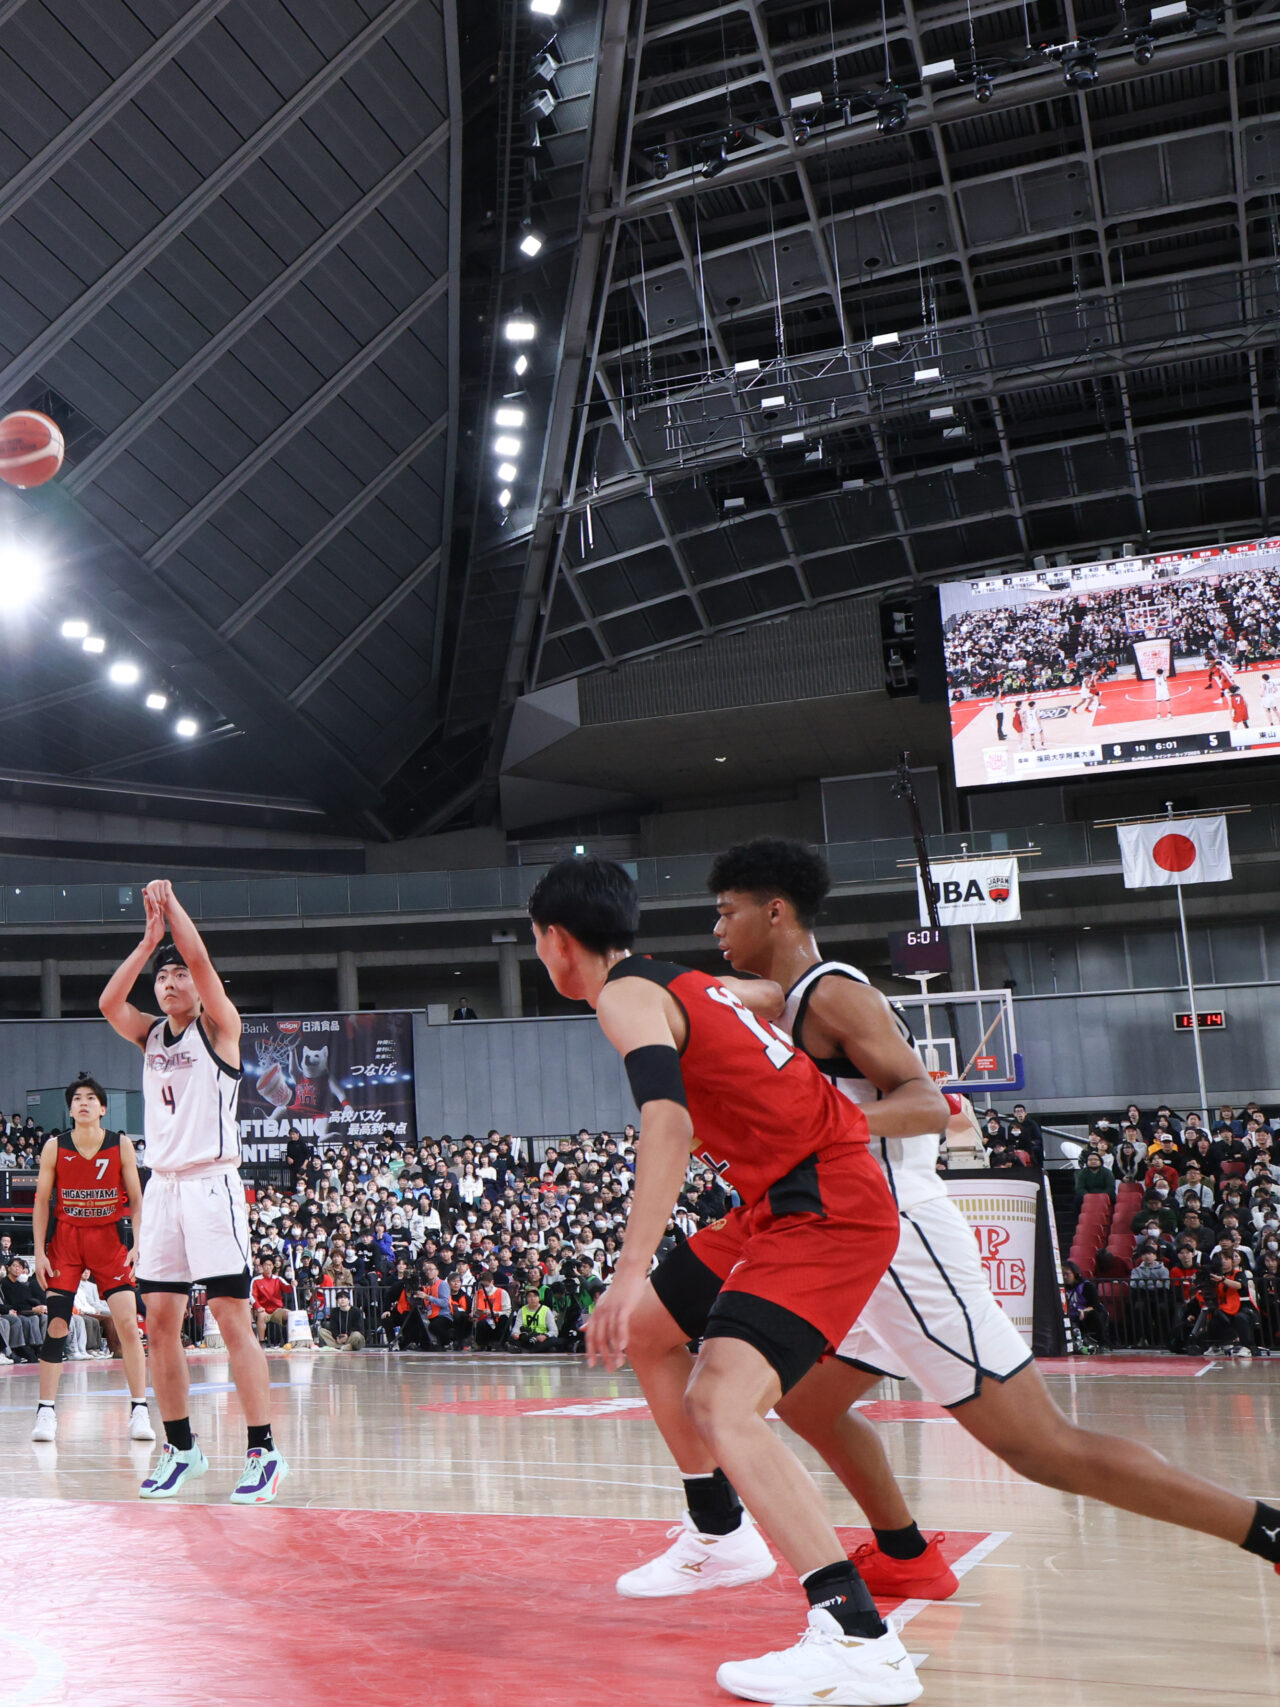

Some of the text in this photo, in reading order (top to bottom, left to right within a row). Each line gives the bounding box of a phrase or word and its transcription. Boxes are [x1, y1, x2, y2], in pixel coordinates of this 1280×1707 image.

[1155, 741, 1178, 751] 6:01
[1208, 735, 1218, 747] 5
[1113, 745, 1122, 756] 8
[907, 930, 939, 945] 6:01
[241, 1023, 269, 1034] Bank
[302, 1020, 340, 1033] 日清食品
[350, 1062, 398, 1077] つなげ。
[161, 1086, 176, 1115] 4
[328, 1109, 387, 1124] 高校バスケ
[240, 1118, 321, 1138] FTBANK
[347, 1122, 408, 1136] 最高到達点
[95, 1158, 110, 1180] 7
[971, 1225, 1010, 1260] P
